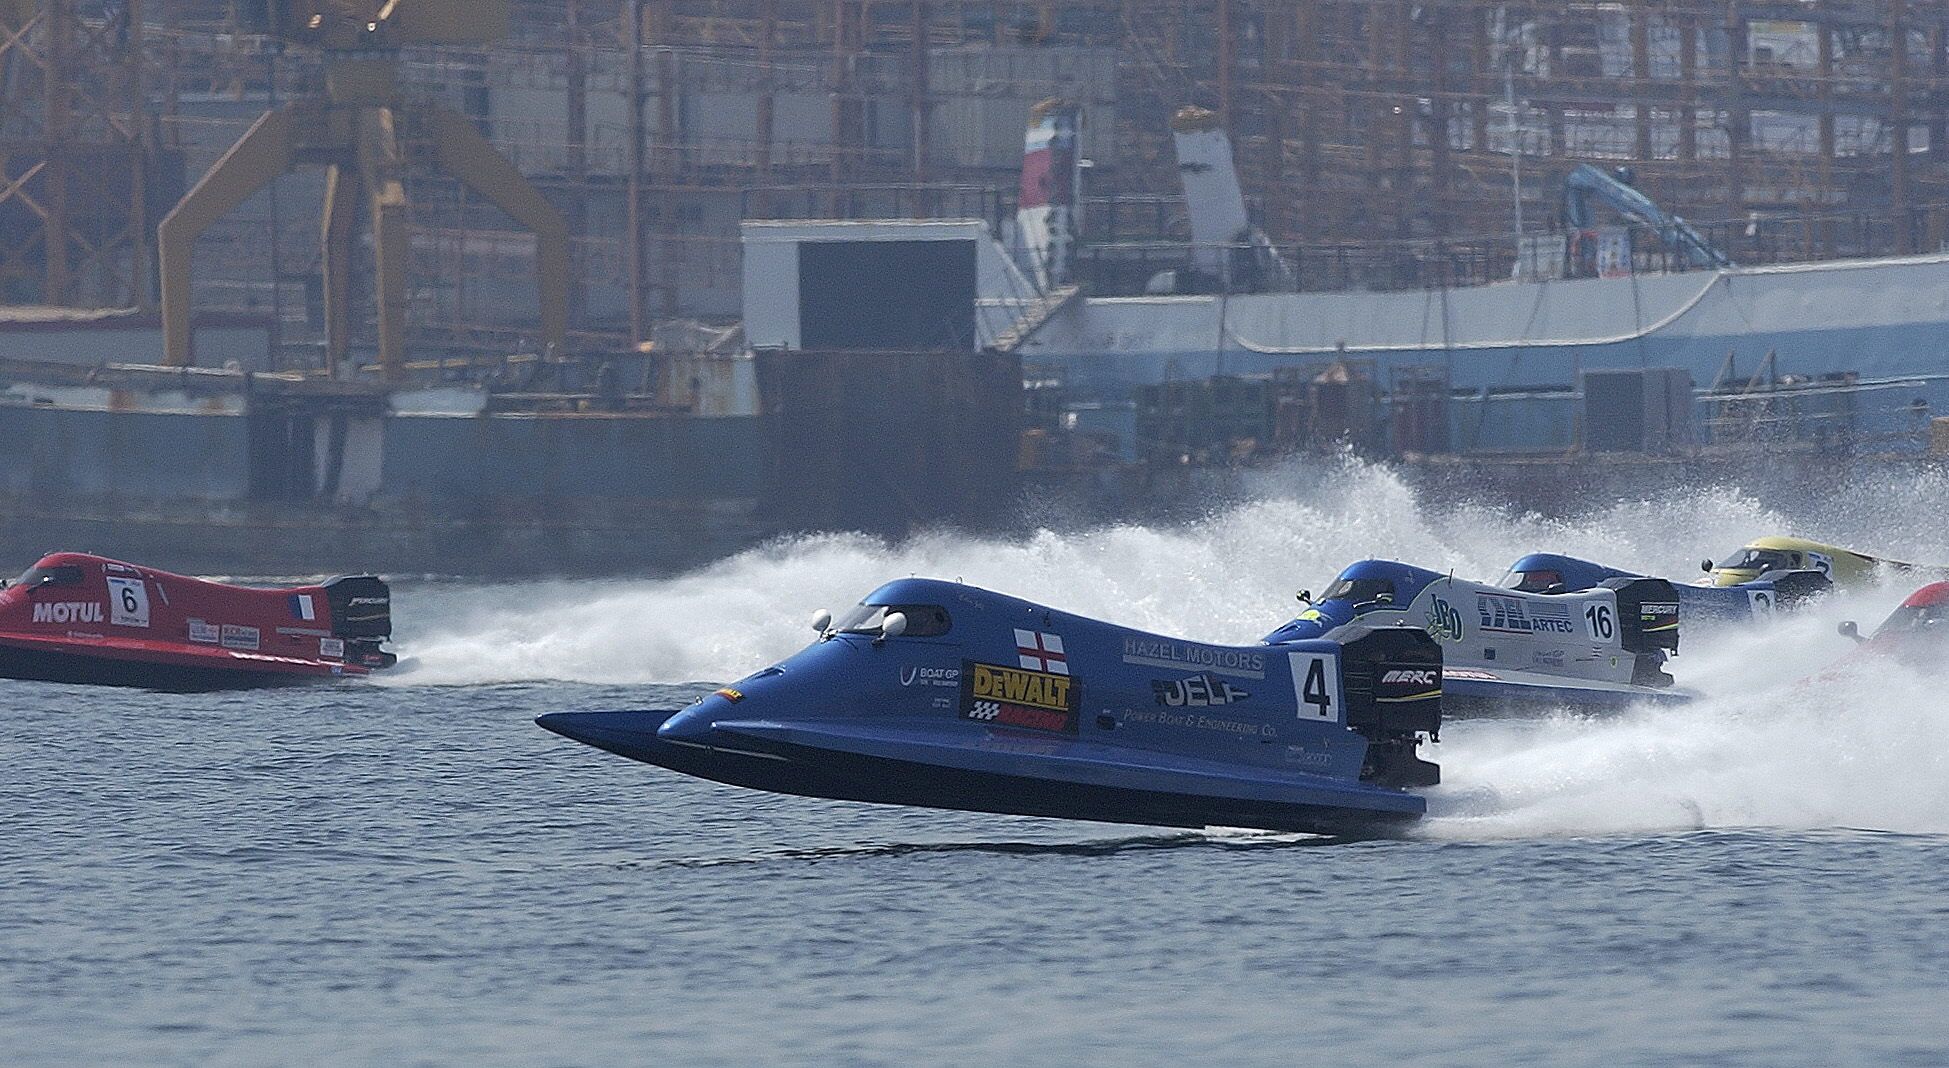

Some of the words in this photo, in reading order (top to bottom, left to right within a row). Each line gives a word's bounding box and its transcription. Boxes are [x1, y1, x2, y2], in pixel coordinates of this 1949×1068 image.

[122, 587, 137, 612] 6
[33, 602, 104, 623] MOTUL
[1585, 605, 1613, 639] 16
[1533, 618, 1574, 633] ARTEC
[1124, 638, 1181, 660] HAZEL
[1186, 648, 1263, 670] MOTORS
[920, 667, 944, 678] BOAT
[945, 669, 959, 679] GP
[1382, 670, 1437, 685] MERC
[1304, 659, 1331, 716] 4
